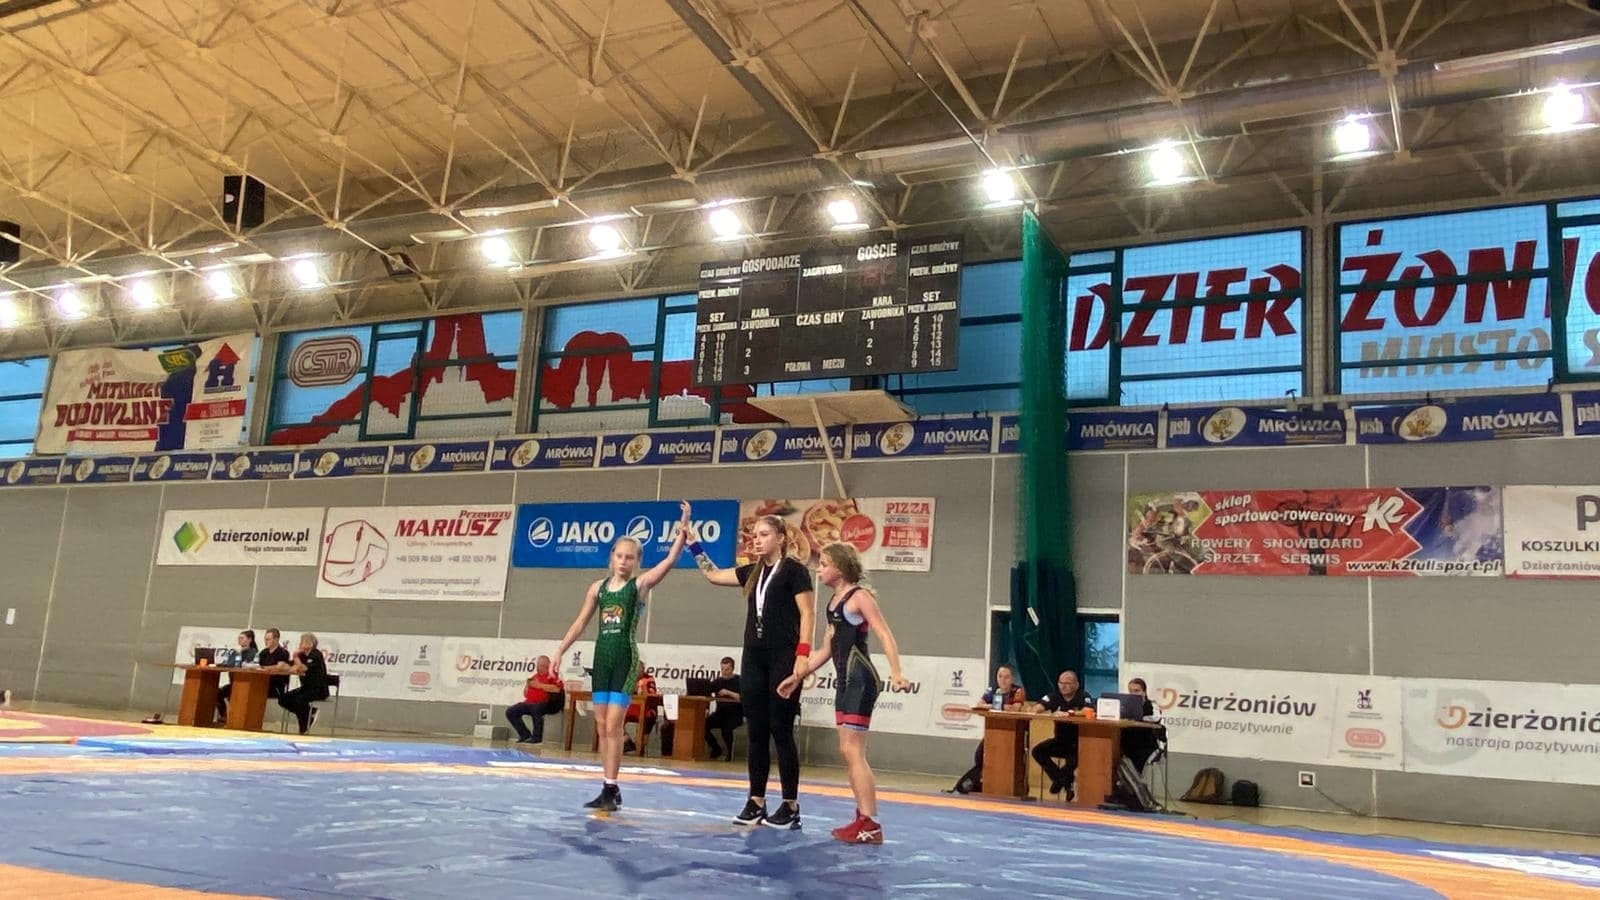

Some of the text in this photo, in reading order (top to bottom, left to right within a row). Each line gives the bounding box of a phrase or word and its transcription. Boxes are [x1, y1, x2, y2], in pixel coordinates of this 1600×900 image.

[857, 242, 897, 261] GOŚCIE
[911, 245, 927, 255] CZAS
[742, 255, 800, 273] GOSPODARZE
[803, 264, 842, 277] ZAGRYWKA
[873, 295, 892, 307] KARA
[923, 291, 941, 302] SET
[709, 312, 725, 322] SET
[751, 308, 769, 319] KARA
[796, 311, 844, 326] CZAS GRY
[862, 307, 905, 320] ZAWODNIKA
[914, 314, 943, 324] 4 10
[741, 318, 780, 330] ZAWODNIKA
[870, 321, 874, 330] 1
[914, 323, 941, 333] 5 11
[748, 331, 753, 340] 1
[913, 331, 942, 341] 6 12
[867, 338, 873, 348] 2
[913, 340, 941, 350] 7 13
[745, 348, 751, 357] 2
[912, 349, 941, 359] 8 14
[1360, 328, 1549, 378] MIASTO
[822, 358, 846, 370] MECZU
[866, 355, 872, 366] 3
[911, 358, 941, 368] 9 15
[743, 365, 750, 375] 3
[1258, 415, 1342, 433] MRÓWKA
[1462, 409, 1559, 431] MRÓWKA
[923, 427, 989, 444] MRÓWKA
[1080, 421, 1155, 439] MRÓWKA
[545, 444, 593, 459] MRÓWKA
[658, 439, 712, 455] MRÓWKA
[440, 449, 485, 463] MRÓWKA
[886, 502, 930, 514] PIZZA
[1214, 494, 1251, 511] sklep
[459, 509, 513, 520] Przewozy
[1214, 510, 1355, 526] sportowo-rowerowy
[1361, 496, 1407, 535] K2
[1576, 495, 1600, 531] P
[394, 519, 502, 537] MARIUSZ
[557, 520, 721, 544] JAKO JAKO
[213, 527, 309, 545] dzierzoniow.pl
[1191, 538, 1364, 549] ROWERY SNOWBOARD
[1522, 540, 1600, 552] KOSZULKI
[1281, 554, 1341, 564] SERWIS
[1347, 559, 1500, 573] www.k2fullsport.pl
[456, 655, 536, 673] Dzierżonió
[646, 663, 721, 682] erżoniów
[1156, 688, 1316, 717] Dzierżoniów
[1437, 706, 1600, 733] Dzierżonió
[1215, 720, 1293, 735] pozytywnie
[1446, 735, 1600, 754] nastraja pozytywni
